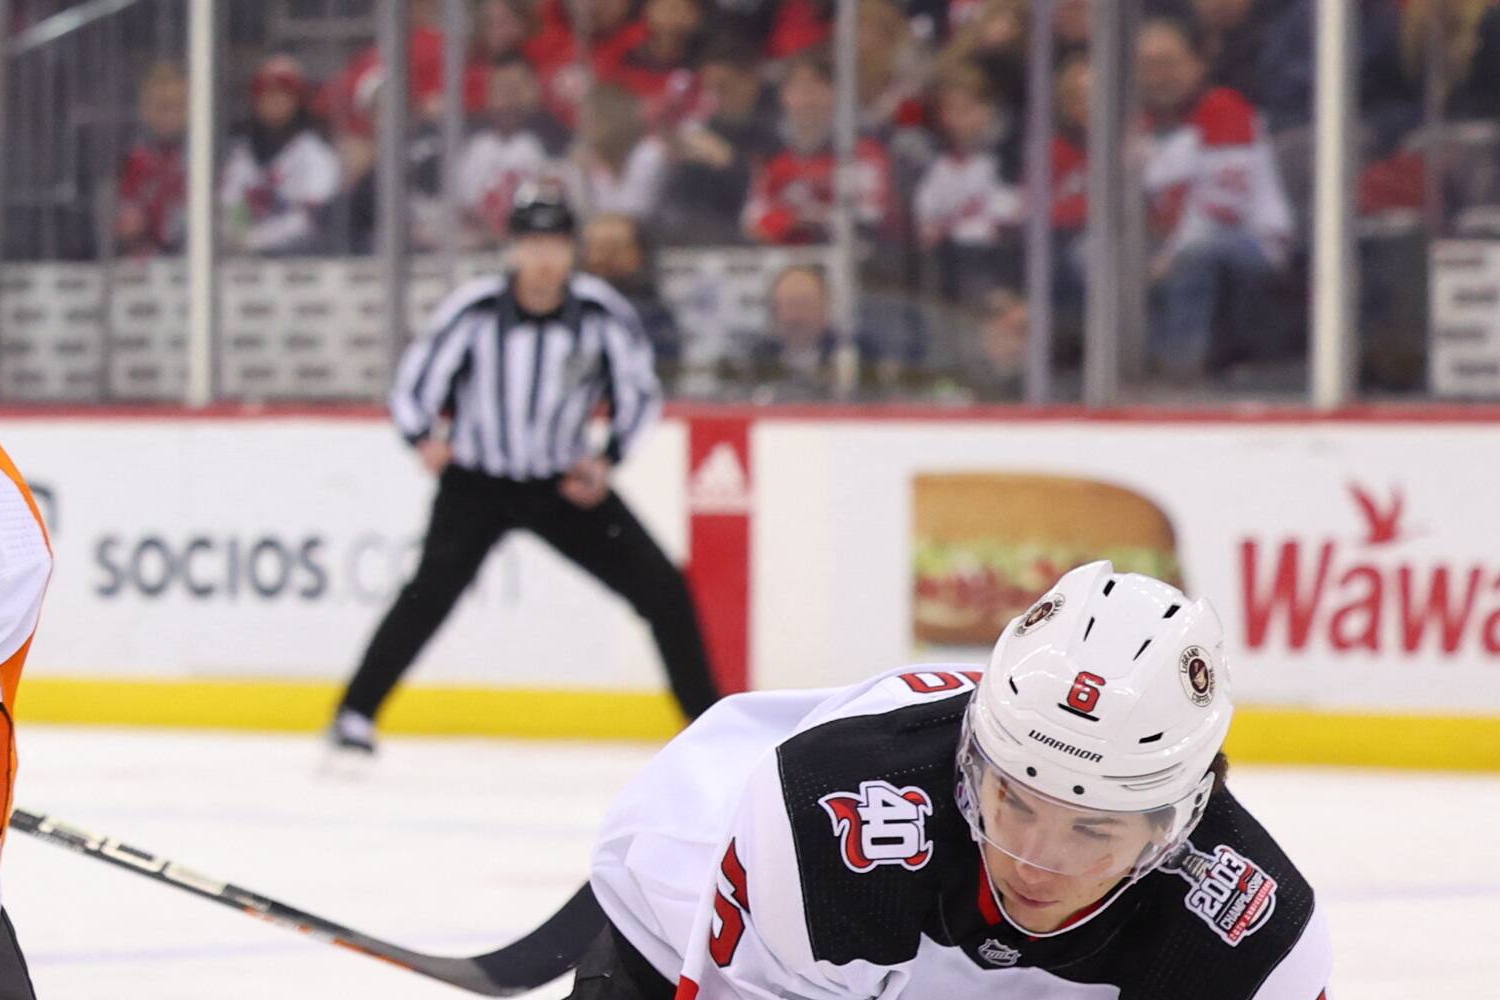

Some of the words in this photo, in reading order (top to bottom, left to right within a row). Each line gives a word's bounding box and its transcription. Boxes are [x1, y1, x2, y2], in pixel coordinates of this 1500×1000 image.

[1067, 671, 1106, 713] 6
[1028, 730, 1104, 763] WARRIOR
[857, 785, 919, 860] 40
[1190, 851, 1247, 920] 2003
